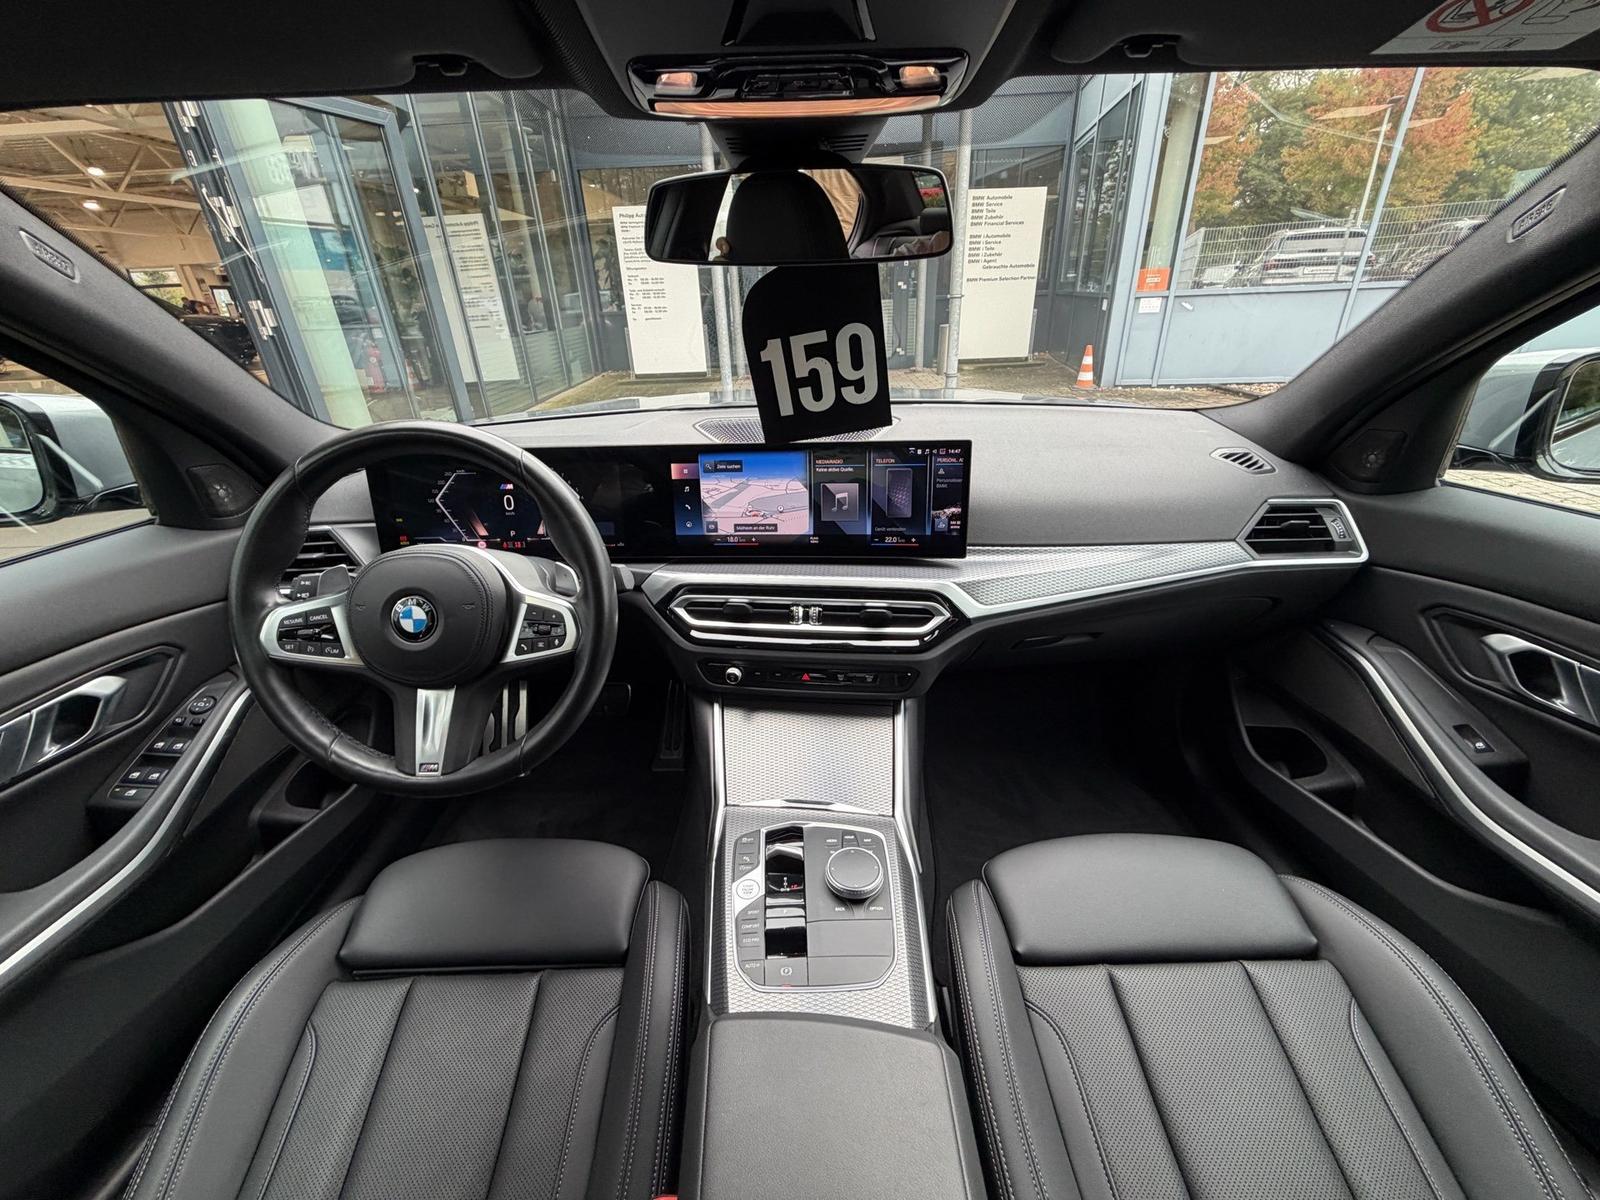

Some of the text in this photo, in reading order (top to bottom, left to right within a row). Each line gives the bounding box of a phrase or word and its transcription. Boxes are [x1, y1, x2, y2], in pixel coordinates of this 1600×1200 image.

[760, 322, 878, 417] 159
[503, 495, 515, 511] 0
[395, 598, 432, 613] BMW
